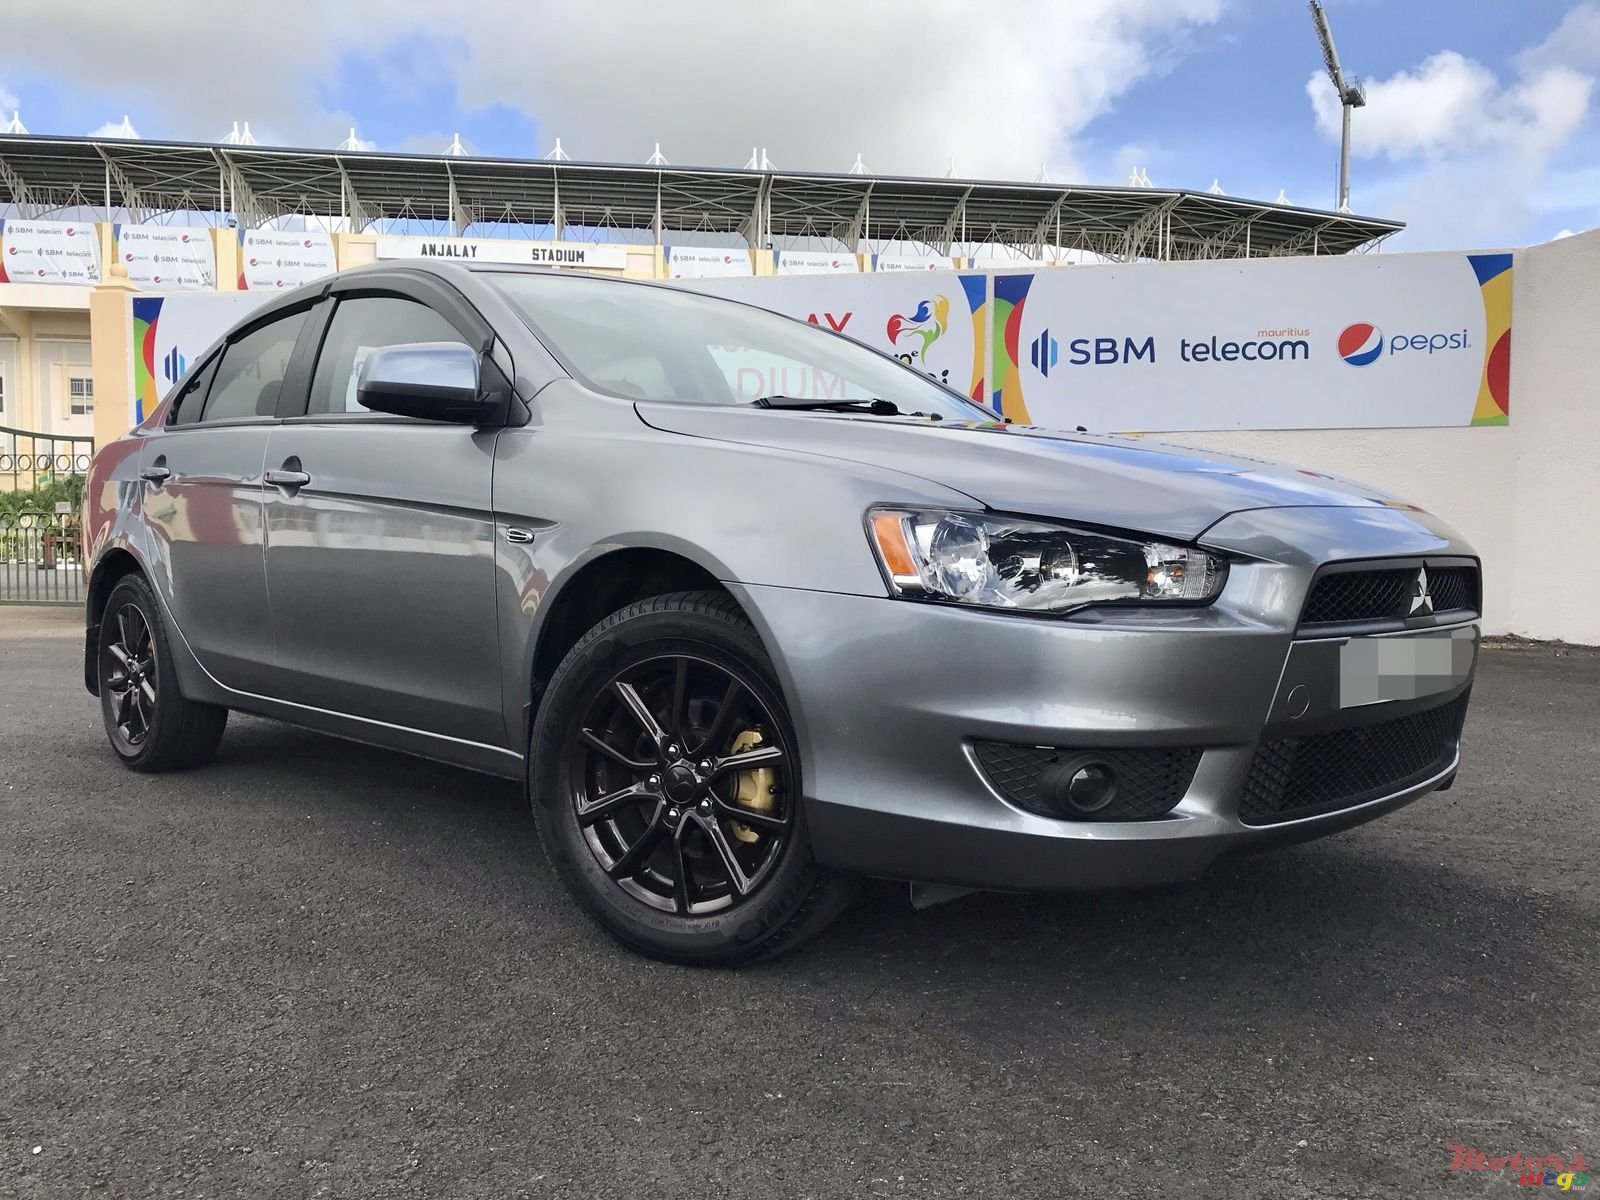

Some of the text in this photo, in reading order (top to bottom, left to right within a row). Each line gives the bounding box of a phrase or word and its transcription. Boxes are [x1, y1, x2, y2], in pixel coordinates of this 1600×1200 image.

[421, 244, 585, 263] ANJALAY STADIUM
[1257, 327, 1311, 337] mauritius
[1069, 329, 1468, 365] SBM telecom pepsi
[736, 366, 848, 402] DIUM
